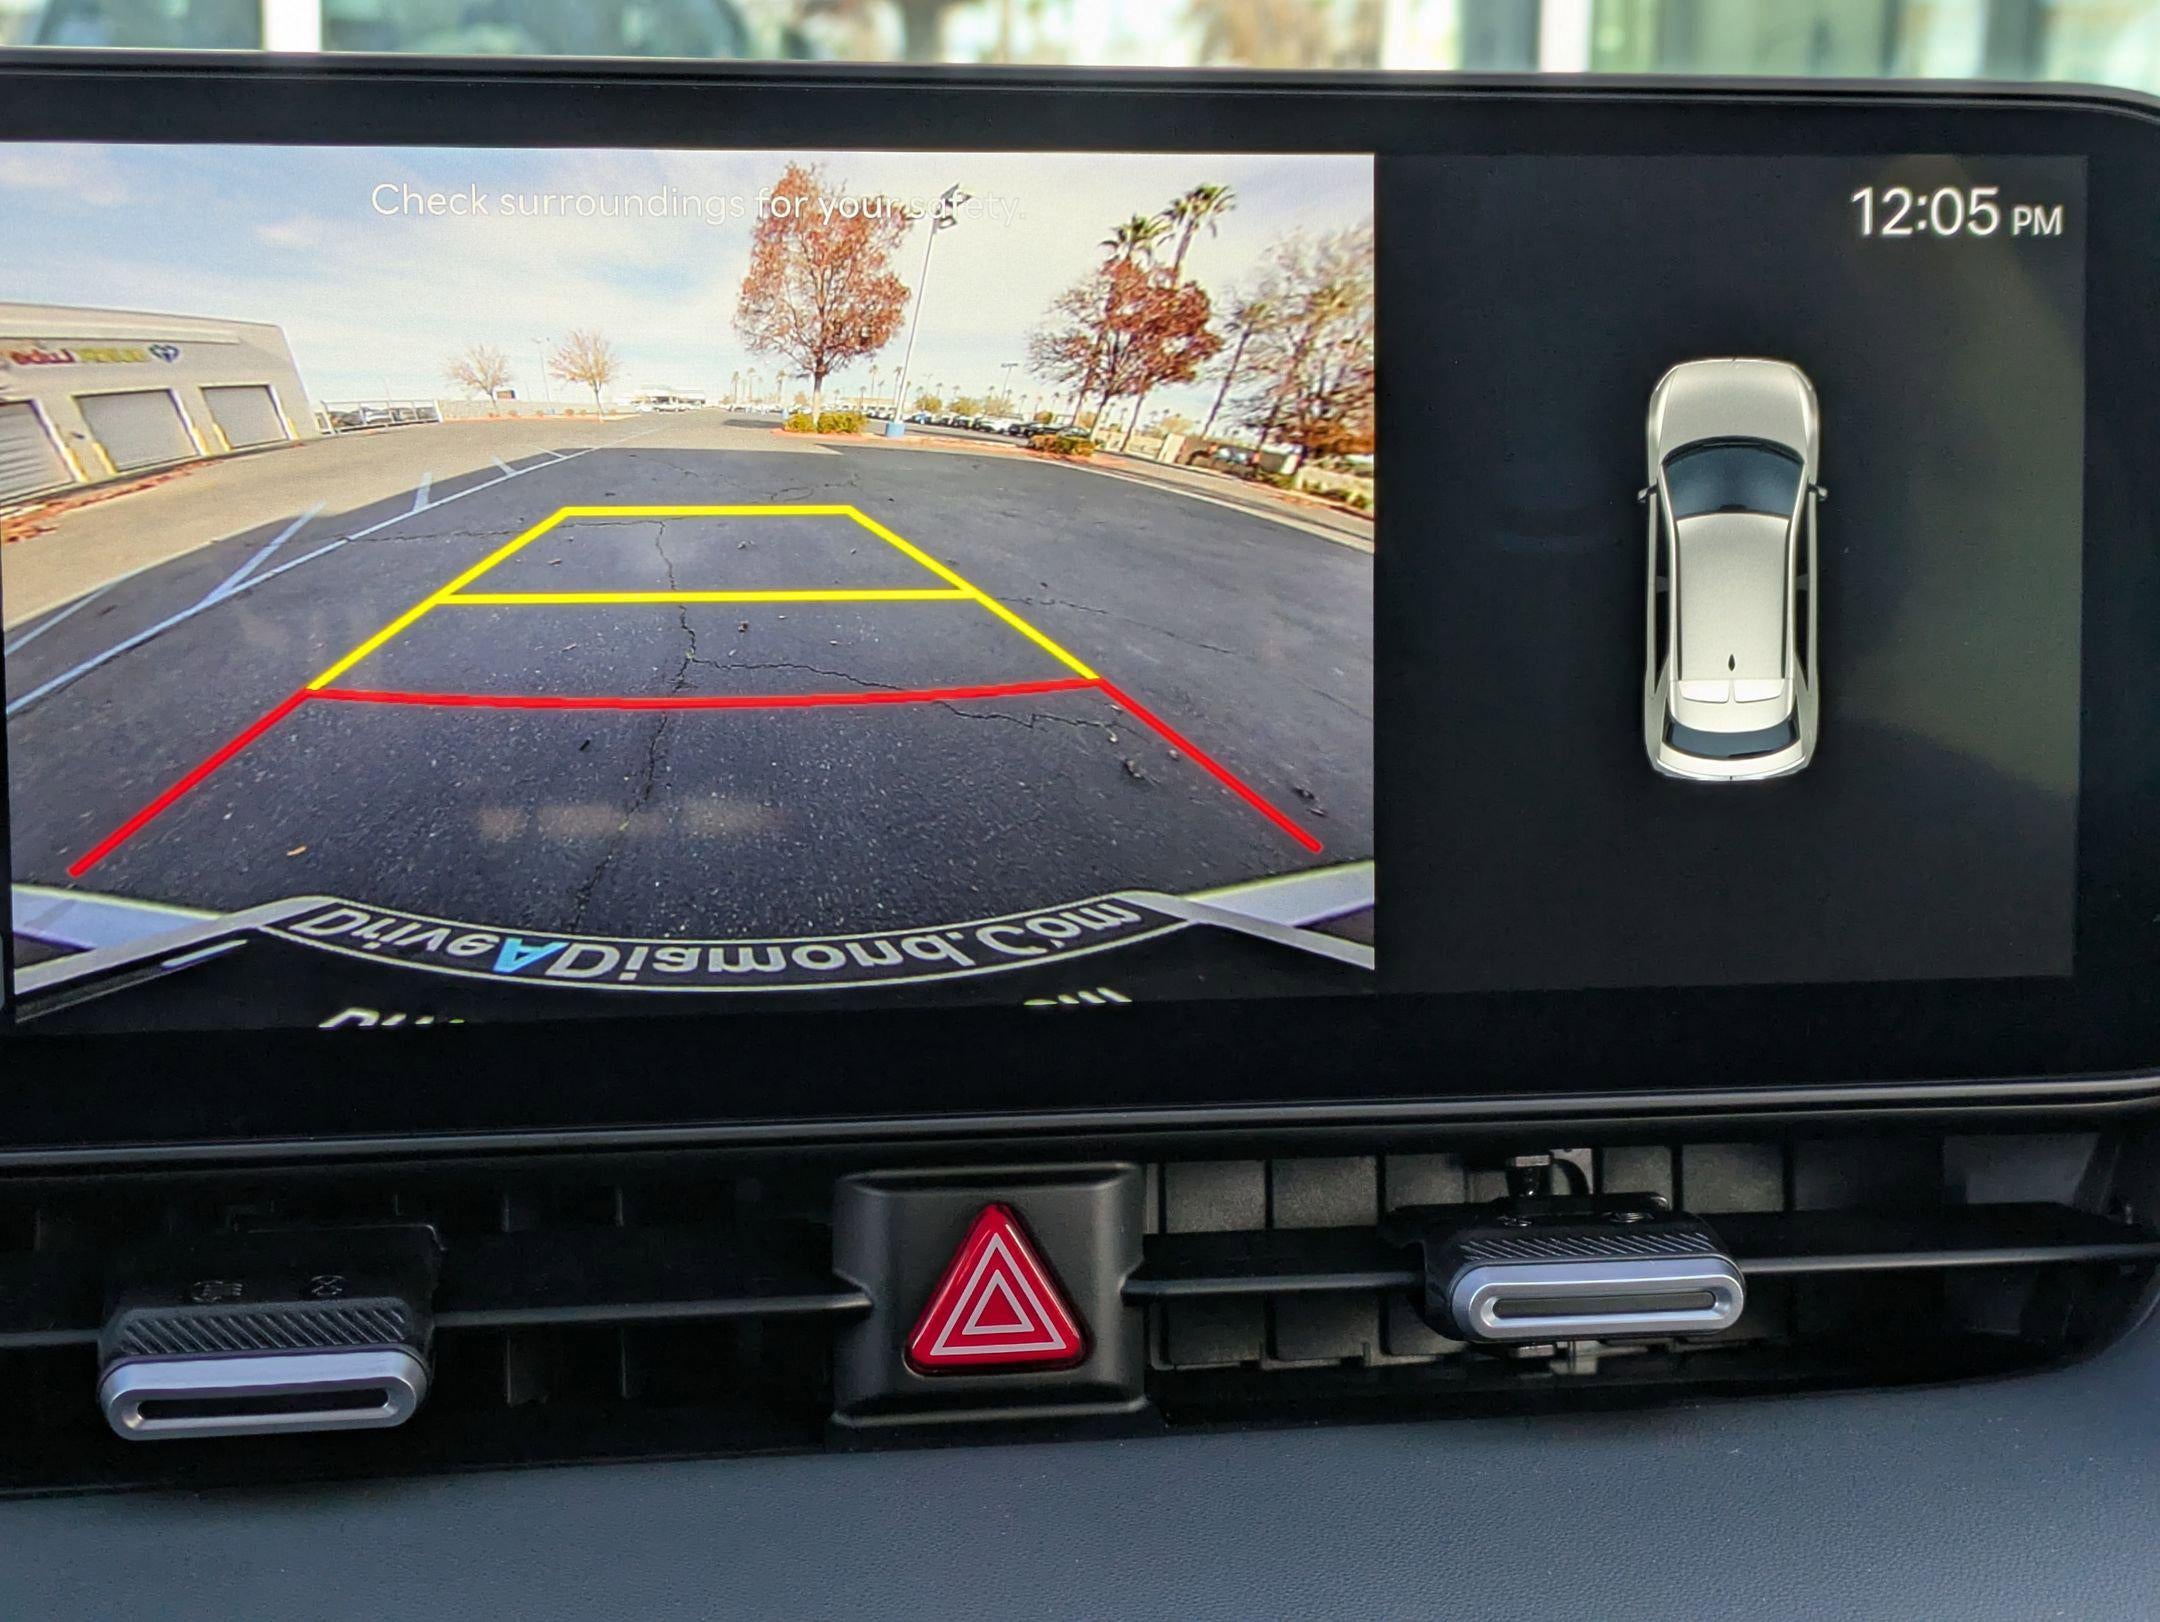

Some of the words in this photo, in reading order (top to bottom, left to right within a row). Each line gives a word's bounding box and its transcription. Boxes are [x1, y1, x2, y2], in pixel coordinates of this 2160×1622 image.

[371, 183, 487, 216] Check
[500, 186, 744, 225] surroundings
[755, 187, 806, 219] for
[819, 192, 895, 224] your
[1851, 186, 2000, 236] 12:05
[2011, 204, 2064, 236] PM
